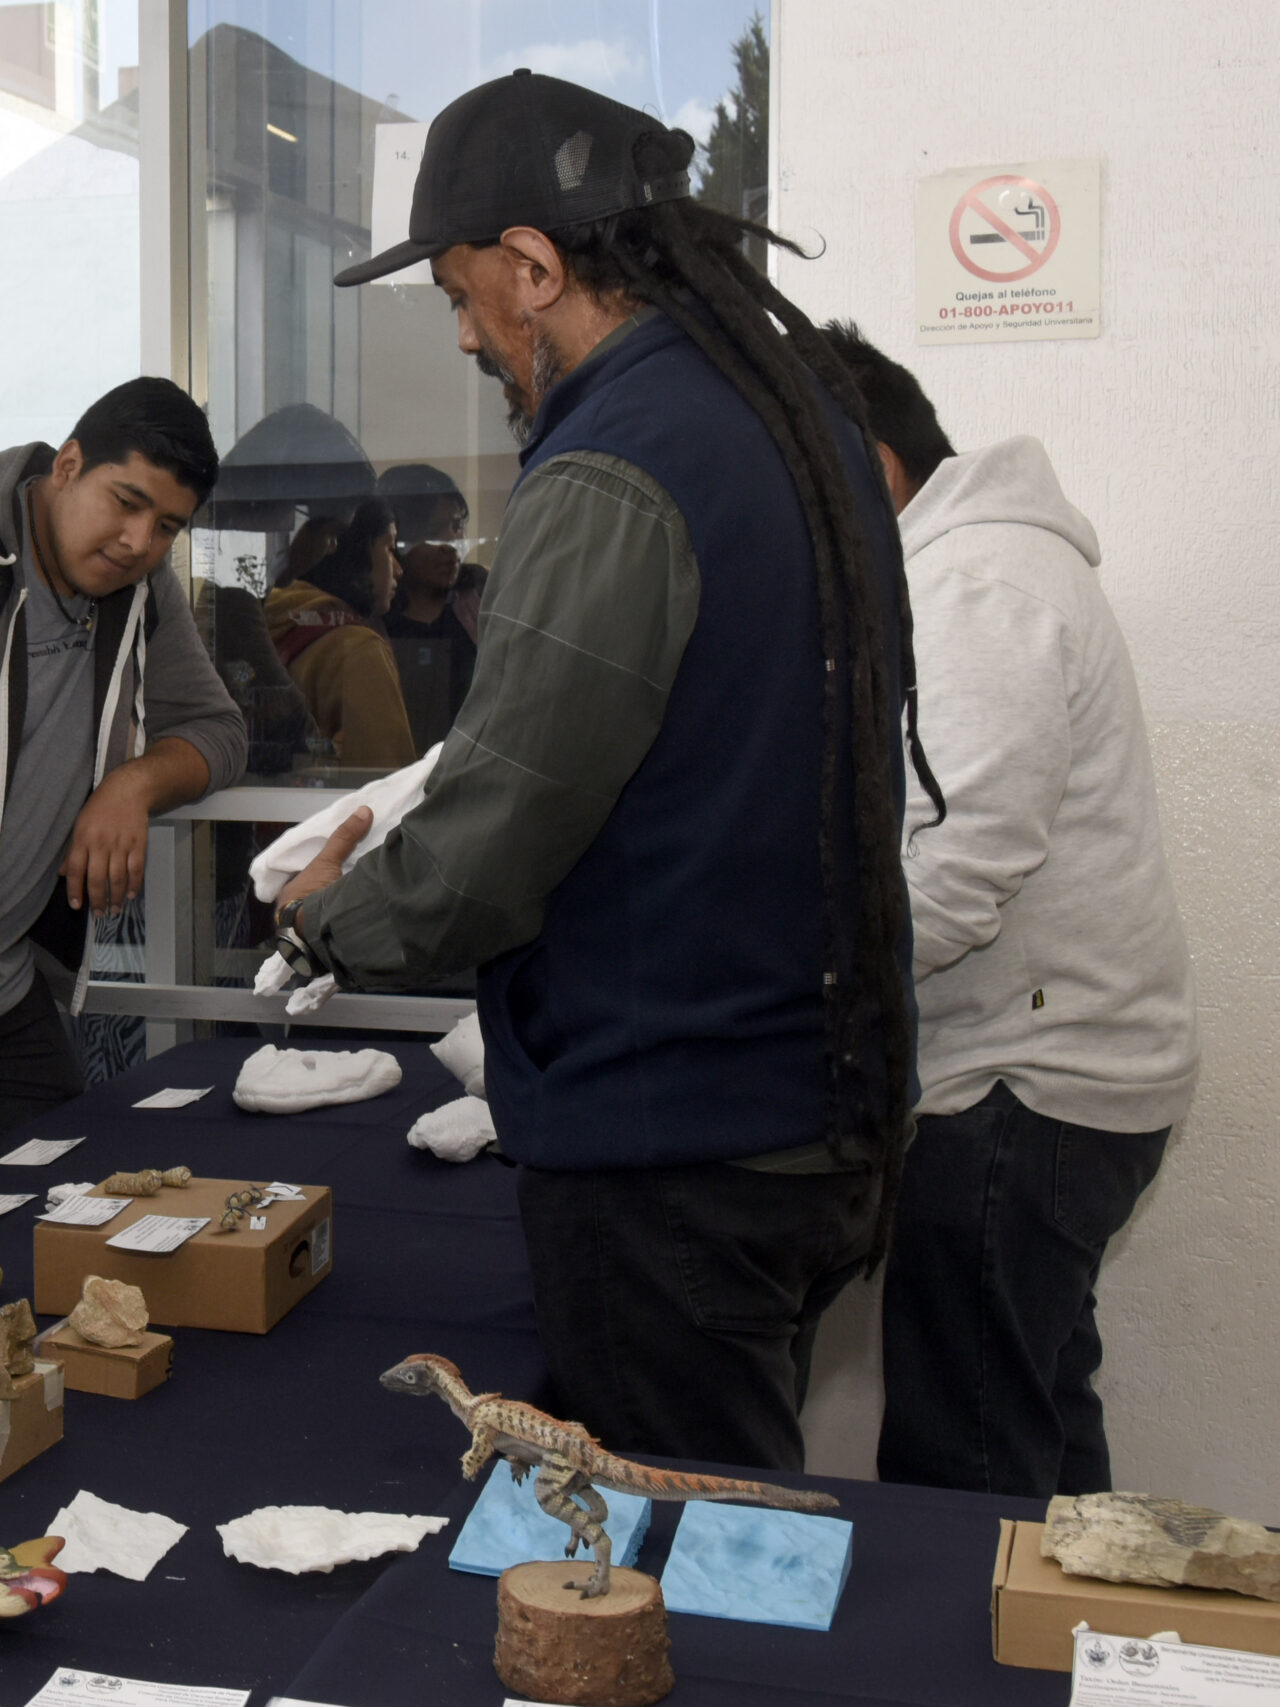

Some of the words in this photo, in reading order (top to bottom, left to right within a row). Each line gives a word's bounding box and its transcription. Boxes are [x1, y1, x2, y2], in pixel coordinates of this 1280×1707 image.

[956, 291, 994, 302] Quejas
[998, 290, 1007, 298] al
[1011, 288, 1056, 298] teléfono
[939, 301, 1074, 319] 01-800-APOYO11
[958, 322, 968, 330] de
[969, 321, 994, 332] Apoyo
[1003, 318, 1042, 329] Seguridad
[1044, 316, 1093, 327] Universitaria
